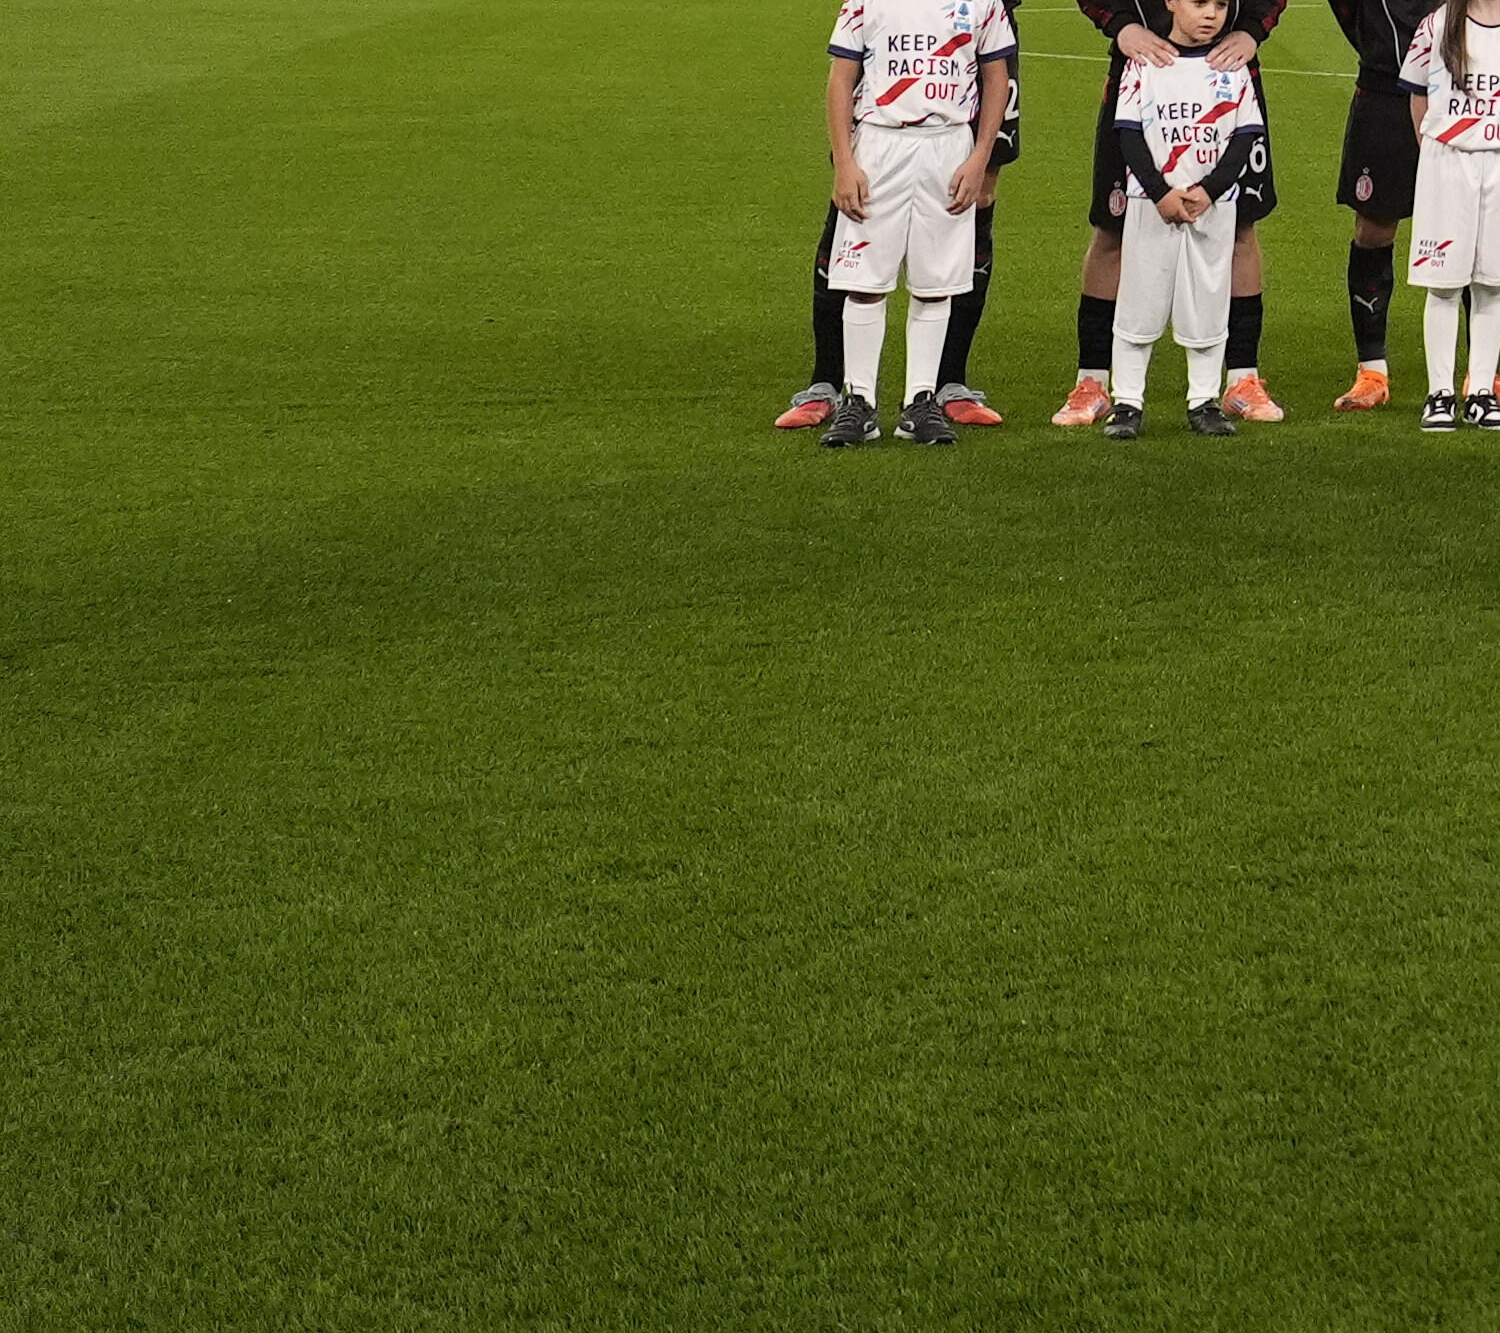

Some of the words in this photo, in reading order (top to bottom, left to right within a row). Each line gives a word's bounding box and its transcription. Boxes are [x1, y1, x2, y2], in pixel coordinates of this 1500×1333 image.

[888, 34, 938, 52] KEEP
[888, 59, 960, 77] RACISM
[924, 82, 960, 100] OUT
[1157, 102, 1203, 120] KEEP
